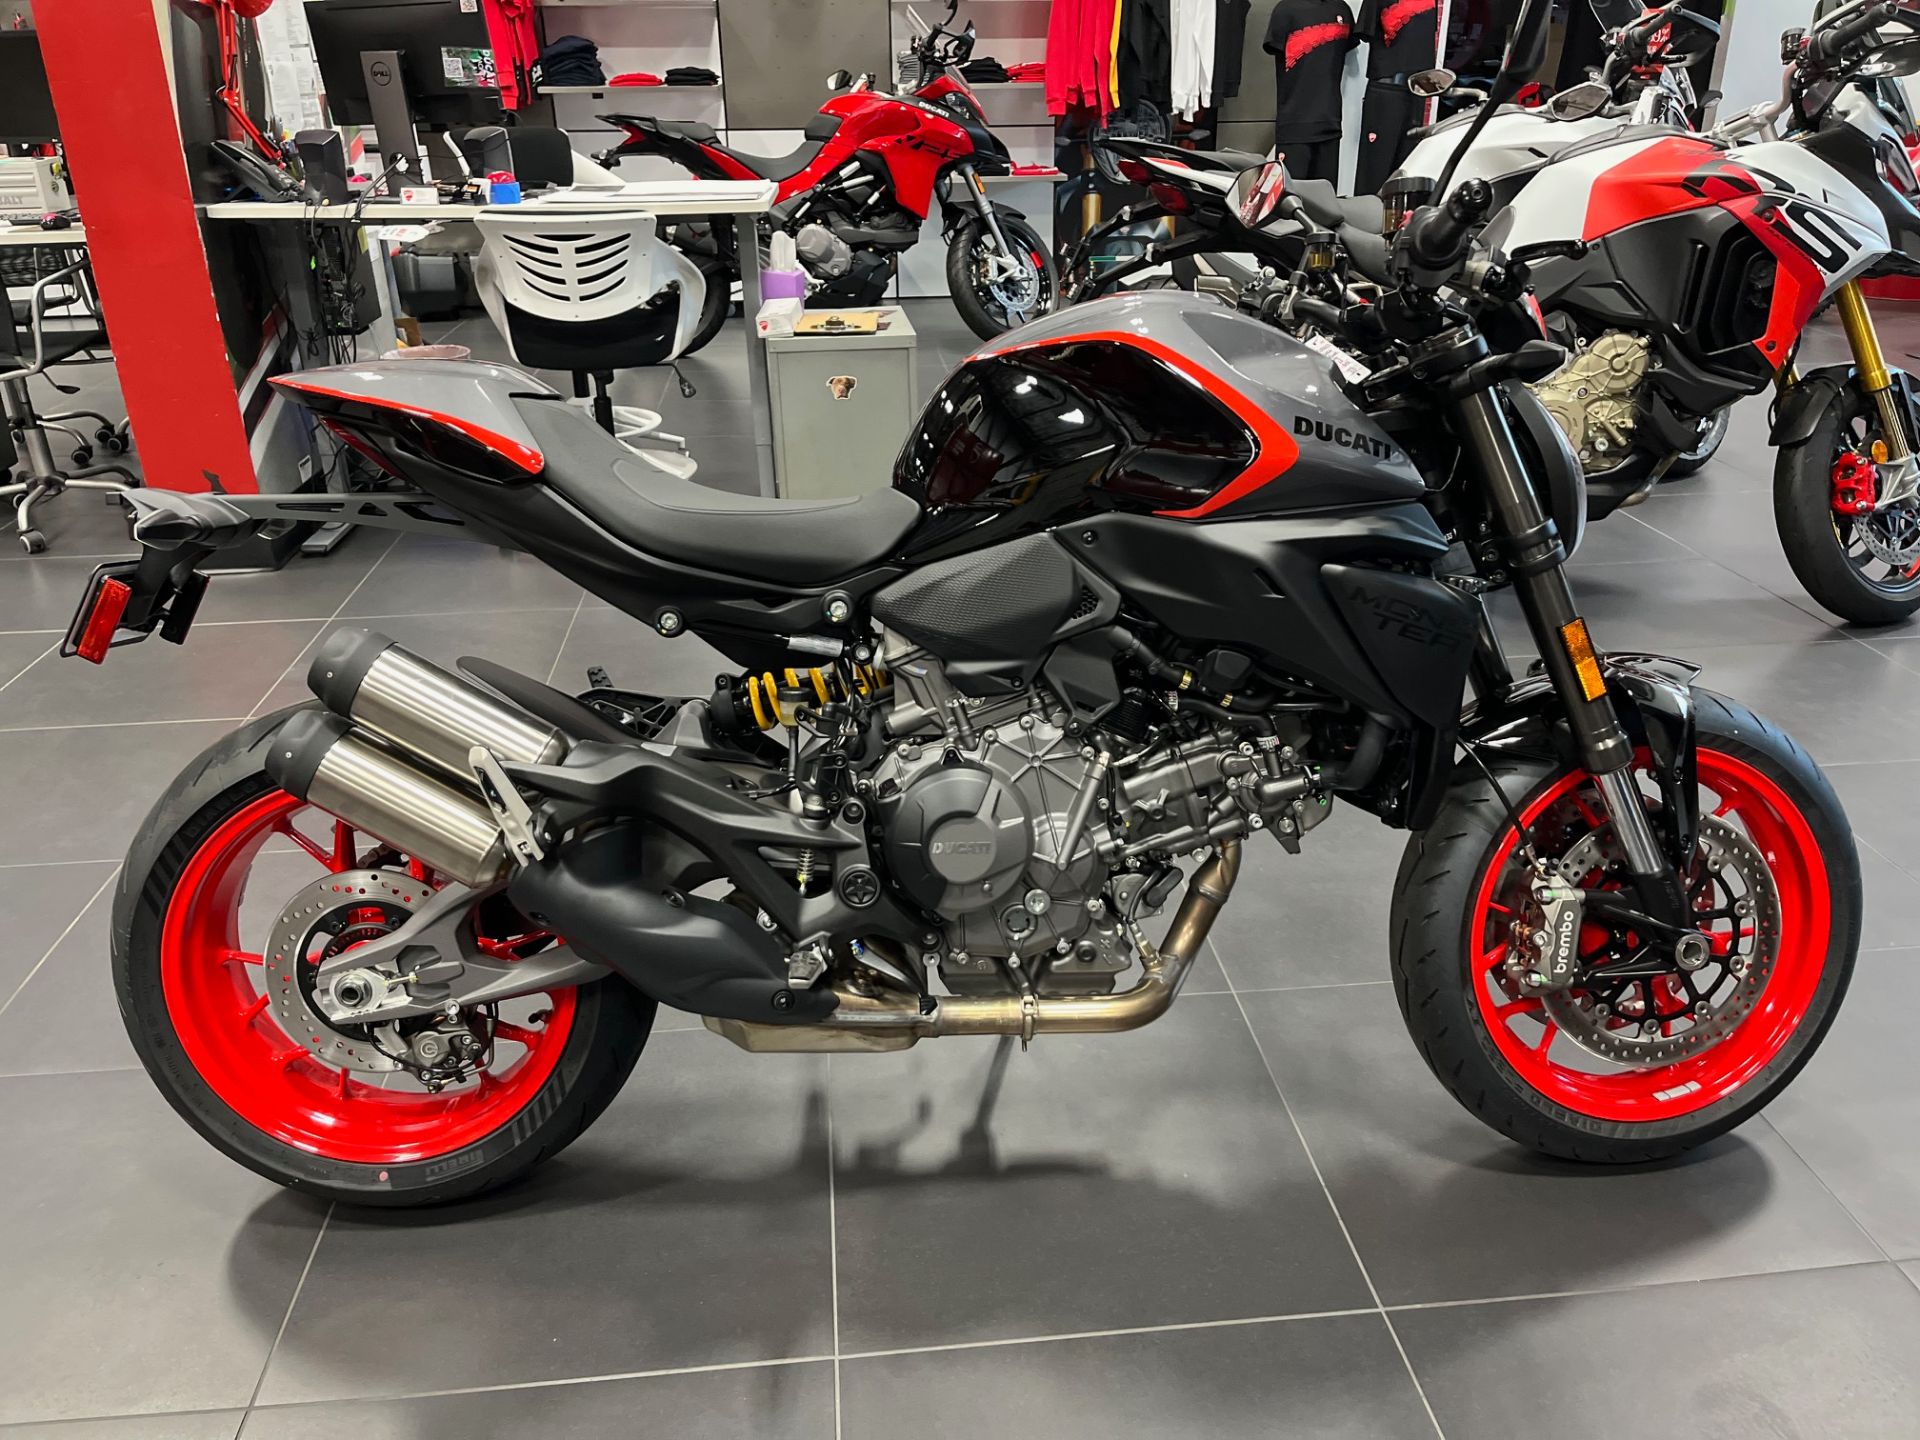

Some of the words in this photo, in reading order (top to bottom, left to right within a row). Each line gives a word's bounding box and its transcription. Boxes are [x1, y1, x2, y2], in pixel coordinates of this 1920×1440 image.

[481, 49, 496, 87] DUCATI
[918, 101, 950, 118] DUCATI
[1293, 415, 1392, 460] DUCATI
[931, 841, 992, 855] DUCATI
[1553, 911, 1574, 974] brembo
